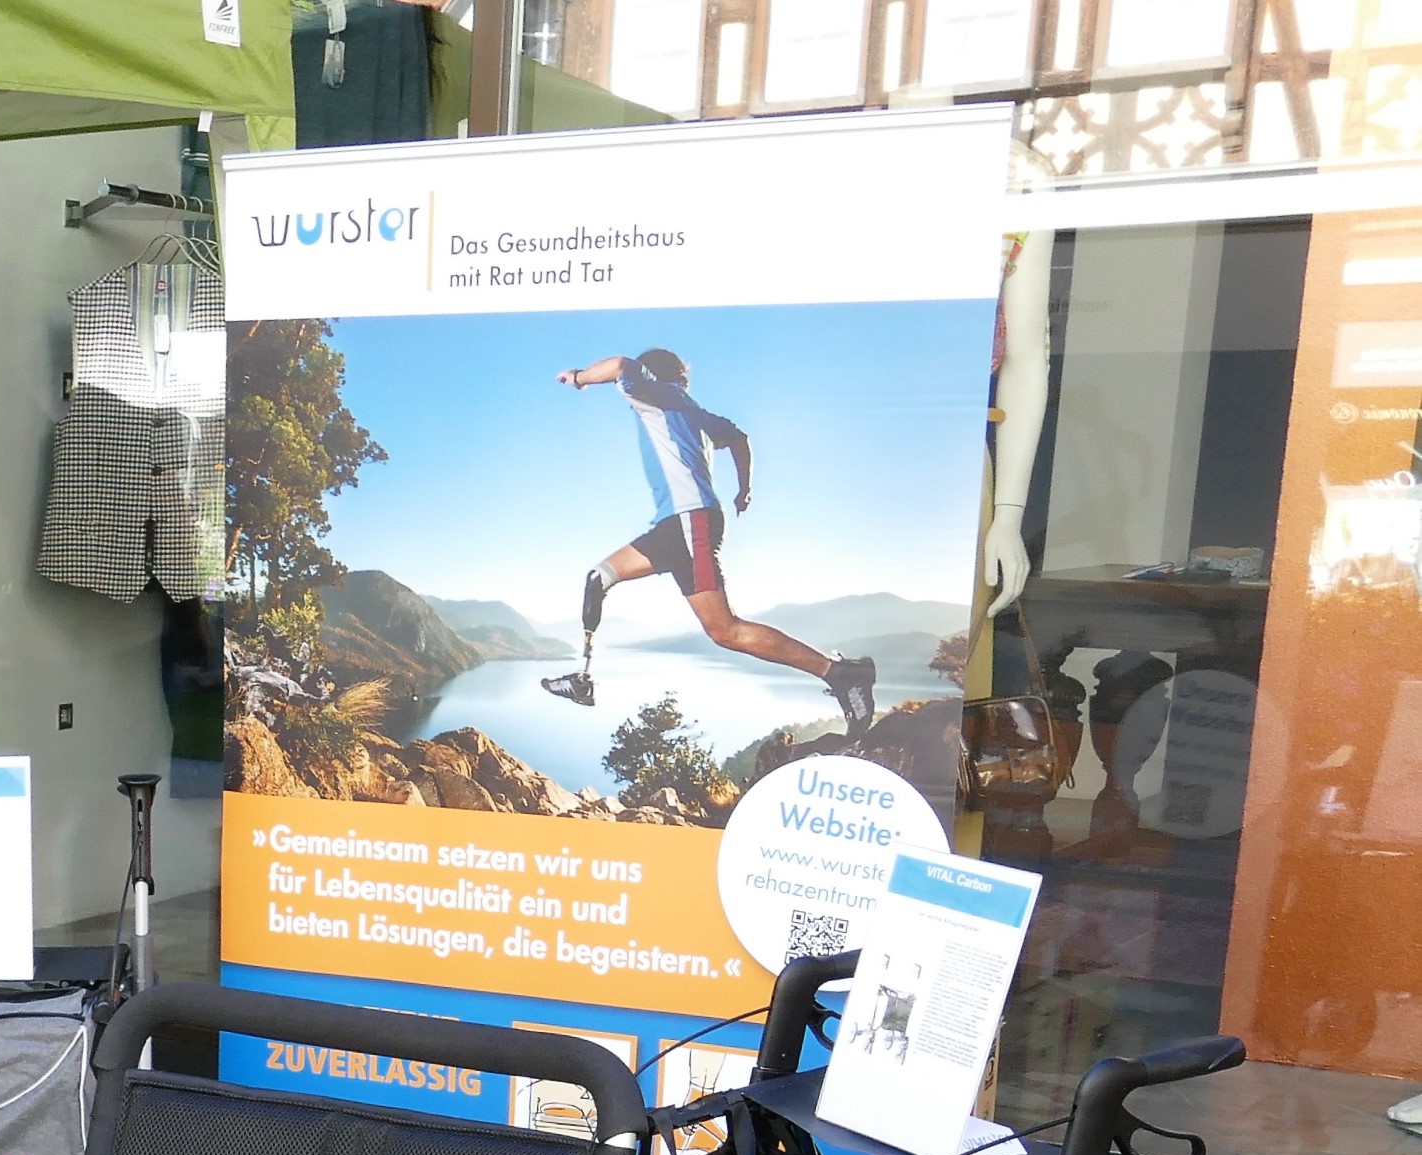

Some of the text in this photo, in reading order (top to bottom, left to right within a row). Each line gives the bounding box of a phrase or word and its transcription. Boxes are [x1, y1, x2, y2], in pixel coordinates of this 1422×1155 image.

[251, 198, 420, 248] wurster
[451, 225, 685, 255] Das Gesundheitshaus
[450, 261, 614, 287] mit Rat und Tat
[798, 768, 895, 809] Unsere
[437, 843, 525, 872] setzen
[535, 847, 582, 877] wir
[591, 858, 643, 884] uns
[927, 865, 993, 894] VITAL Carbon
[269, 862, 628, 925] für Lebensqualität ein und
[269, 902, 349, 939] bieten
[359, 913, 494, 958] Lösungen,
[503, 925, 548, 959] die
